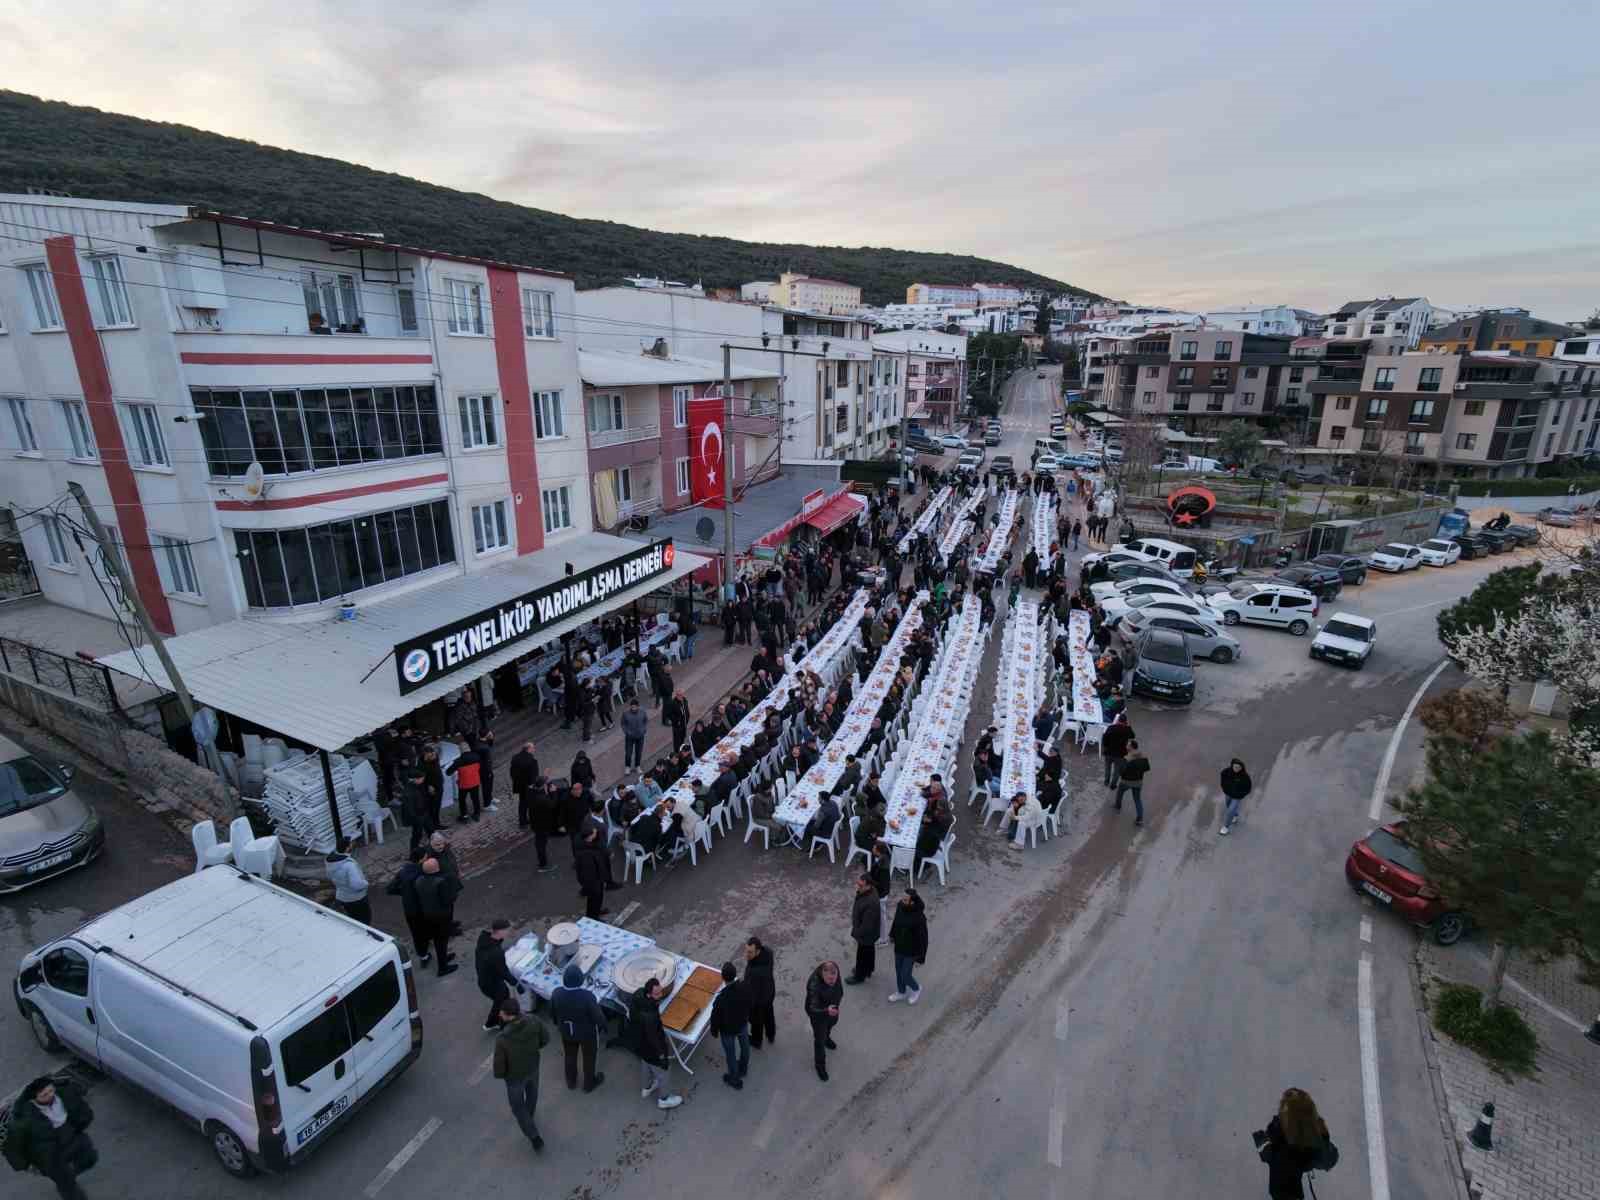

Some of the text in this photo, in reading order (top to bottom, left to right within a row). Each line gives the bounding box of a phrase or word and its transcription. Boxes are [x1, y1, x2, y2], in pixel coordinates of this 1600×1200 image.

[432, 544, 662, 670] TEKNELİKÜP YARDIMLAŞMA DERNEĞİ
